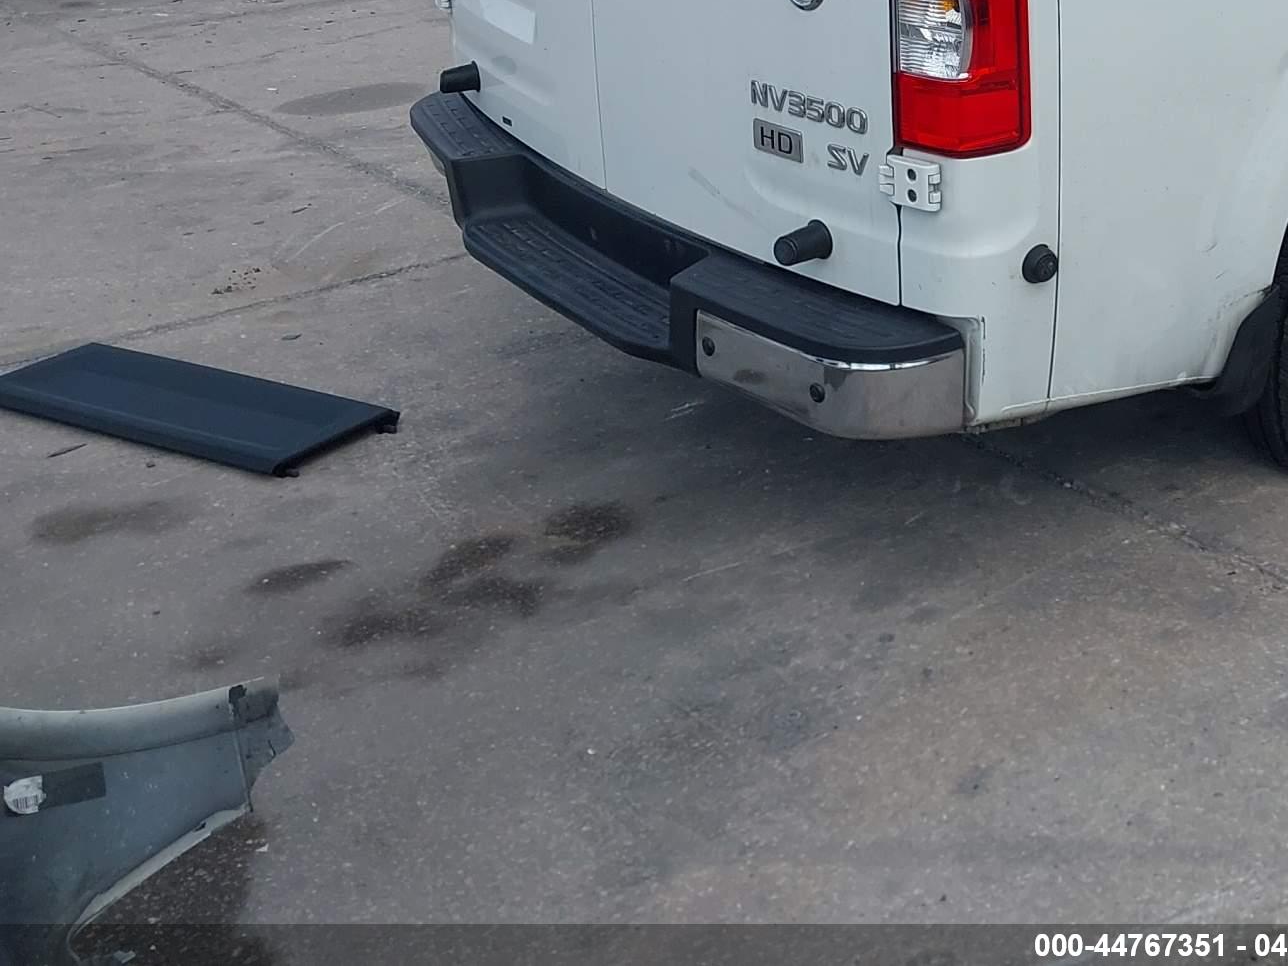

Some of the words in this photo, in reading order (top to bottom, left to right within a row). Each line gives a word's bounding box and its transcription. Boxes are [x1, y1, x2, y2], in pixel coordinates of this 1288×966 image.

[750, 79, 868, 135] NV3500
[760, 126, 793, 155] HD
[827, 143, 870, 176] SV
